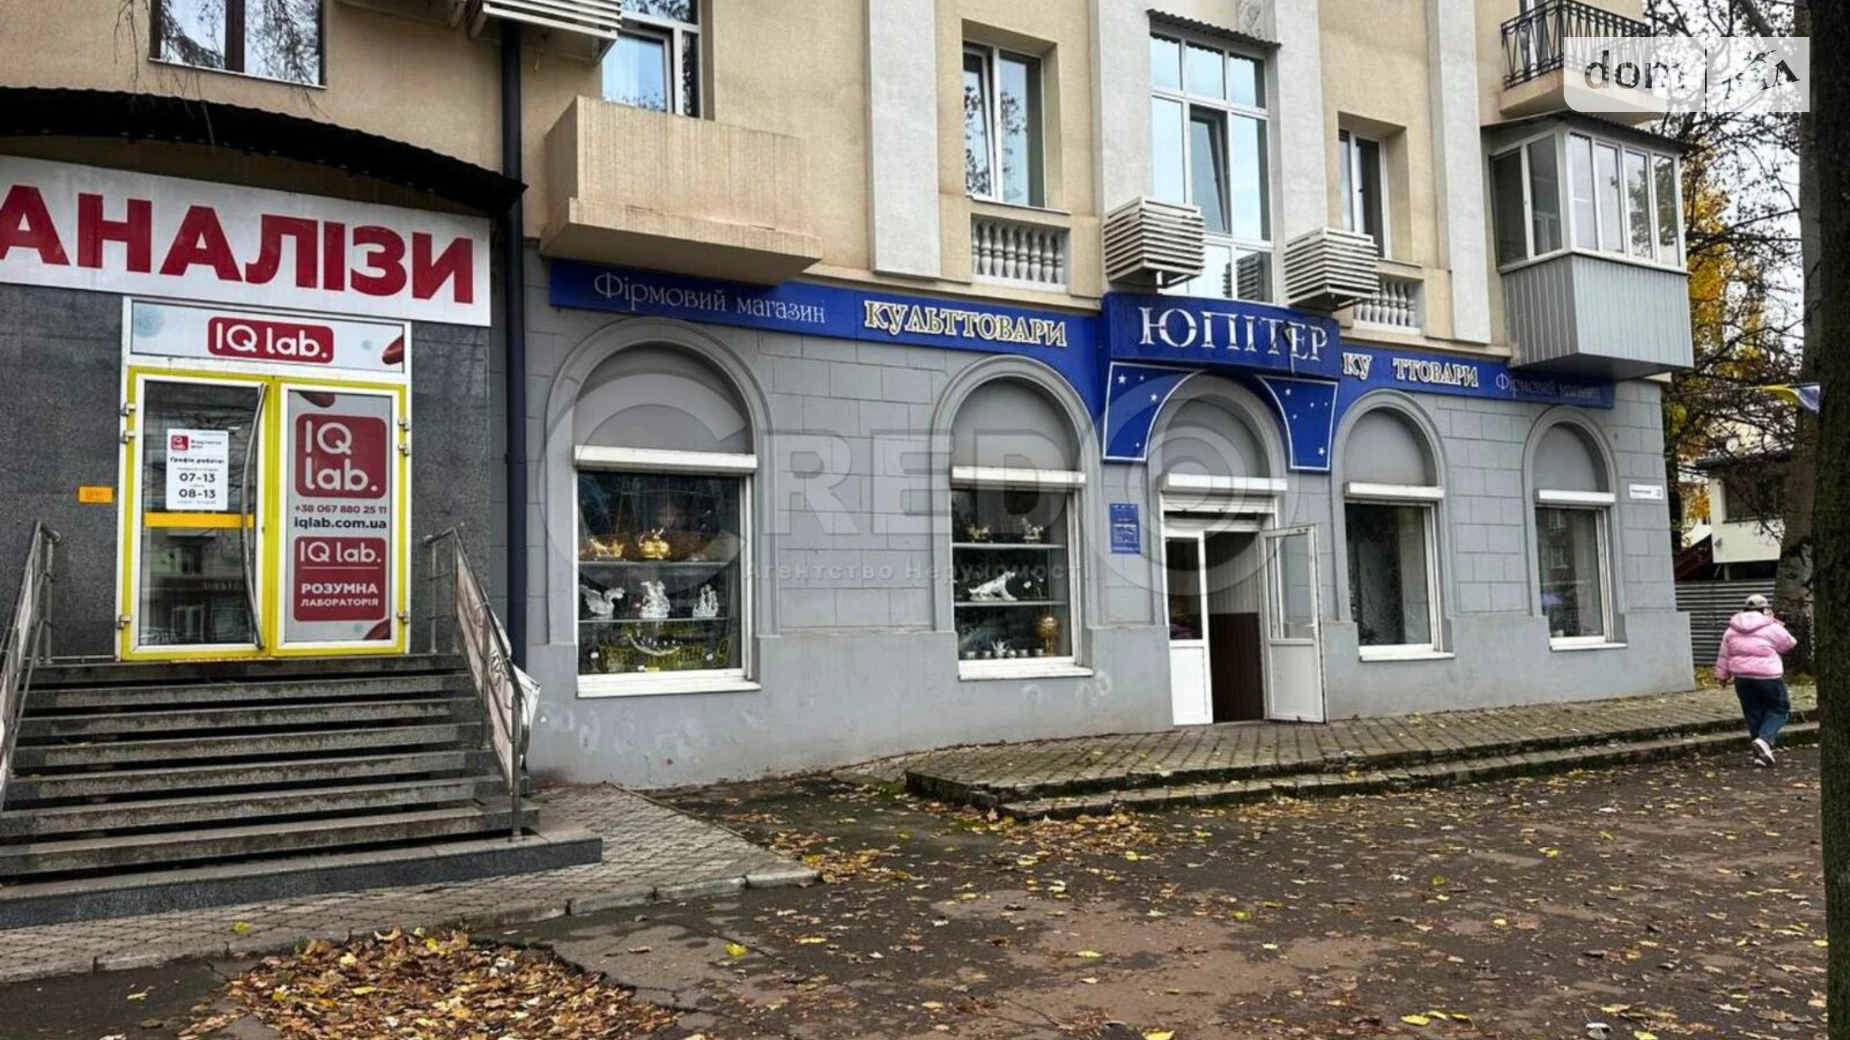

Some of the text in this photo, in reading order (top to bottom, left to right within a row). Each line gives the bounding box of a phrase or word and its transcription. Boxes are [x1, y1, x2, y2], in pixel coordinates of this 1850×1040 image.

[0, 184, 474, 305] АНАЛІЗИ
[593, 273, 826, 325] Фірмовий магазин
[215, 321, 328, 359] IQ lab.
[864, 299, 1067, 348] КУЛЬТТОВАРИ
[1138, 306, 1328, 362] ЮПІТЕР
[1342, 351, 1480, 388] КУ ТТОВАРИ
[305, 420, 353, 455] IQ
[305, 457, 379, 492] lab.
[294, 504, 387, 515] +38 067 880 25 11
[294, 516, 387, 529] iqlab.com.ua
[300, 541, 382, 563] IQ lab.
[300, 598, 379, 607] ЛАБОРАТОРІЯ
[301, 582, 379, 595] РОЗУМНА
